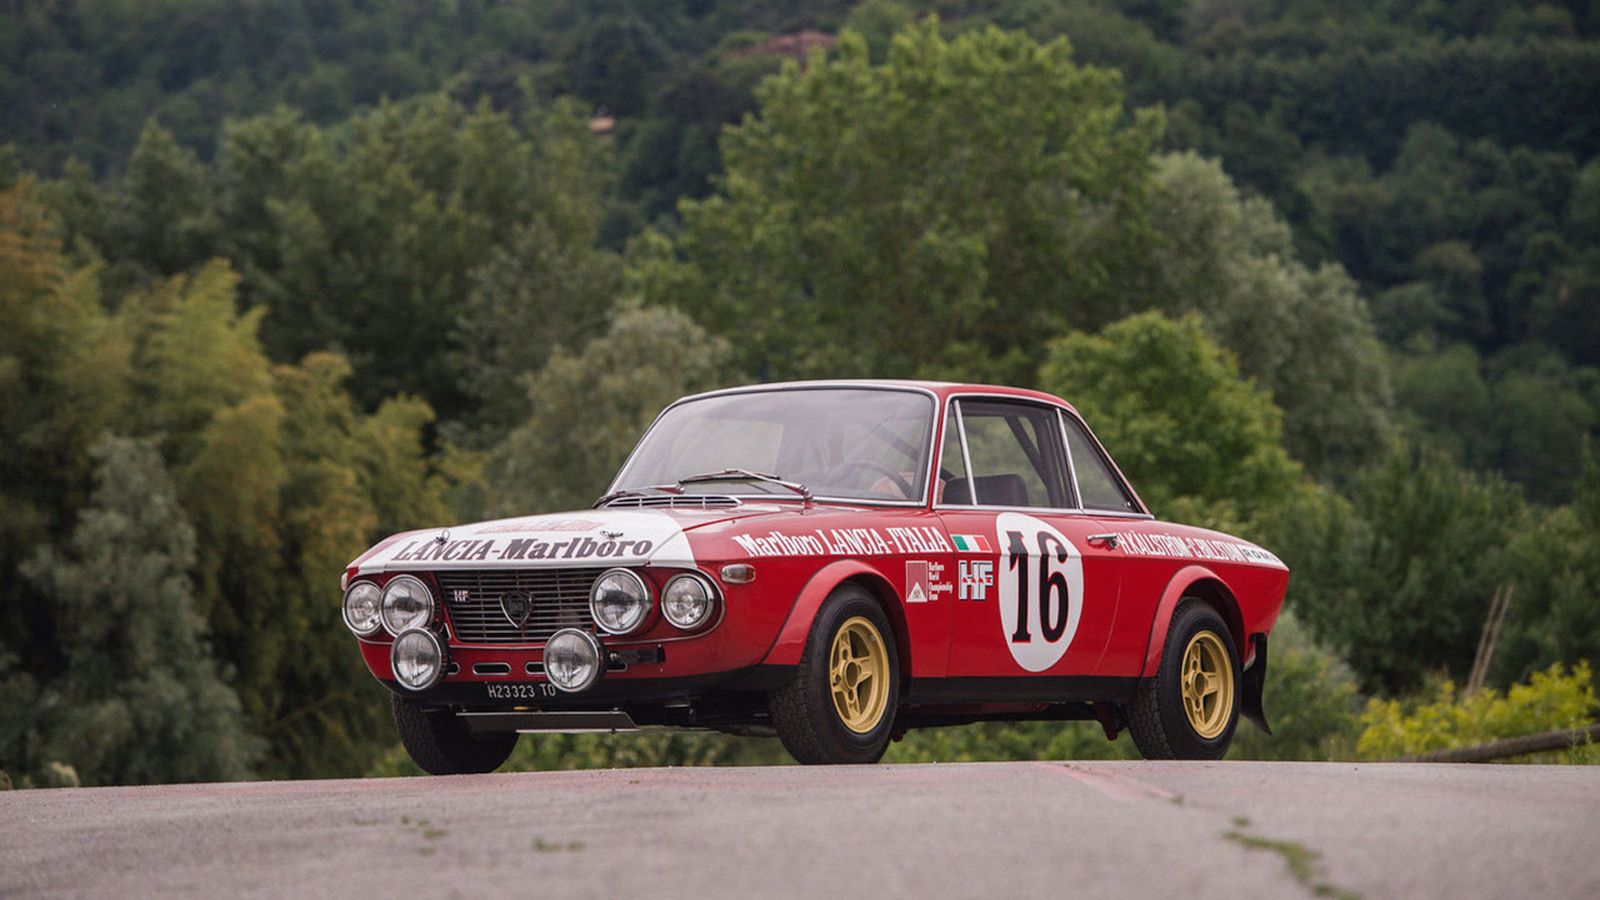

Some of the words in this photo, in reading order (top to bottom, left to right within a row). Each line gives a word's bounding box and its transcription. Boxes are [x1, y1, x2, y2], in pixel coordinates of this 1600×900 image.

[390, 537, 653, 562] LANCIA-Marlboro
[731, 530, 824, 558] Marlboro
[815, 526, 954, 555] LANCIA-ITALIA
[958, 560, 994, 601] HF
[1006, 530, 1070, 644] 16
[454, 590, 469, 602] HF
[487, 684, 535, 699] H23323
[539, 683, 556, 697] TO
